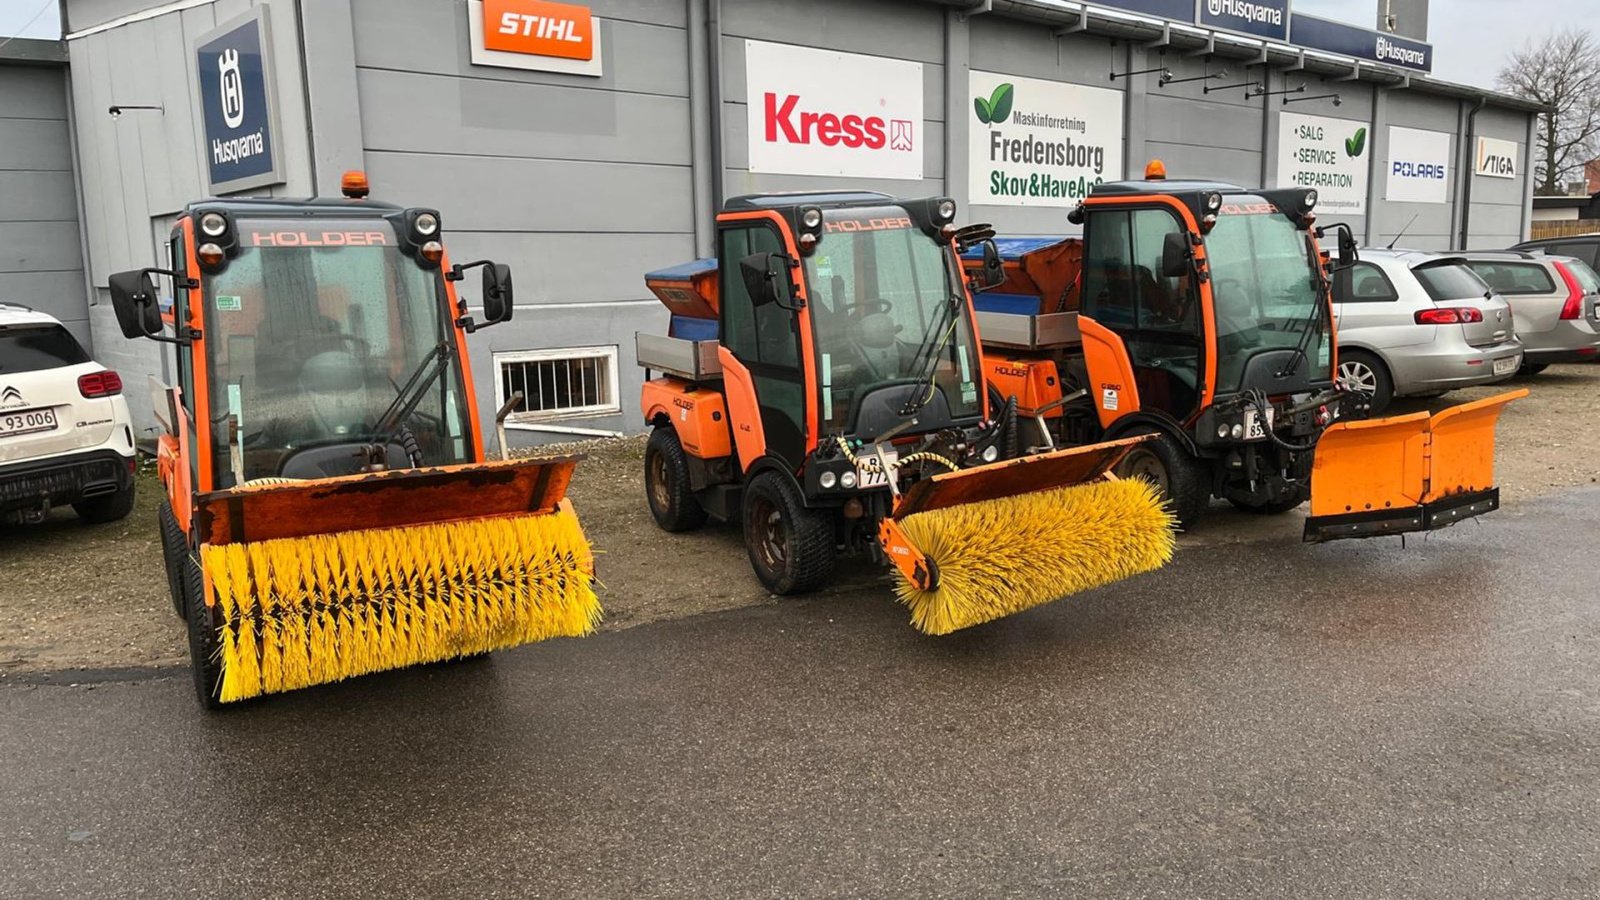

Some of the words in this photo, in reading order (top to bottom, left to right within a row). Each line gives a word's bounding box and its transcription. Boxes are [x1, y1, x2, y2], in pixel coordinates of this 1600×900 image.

[1222, 0, 1281, 25] Husqvarna
[498, 12, 583, 42] STIHL
[1385, 41, 1424, 65] Husqvarna
[764, 92, 886, 150] Kress
[1013, 111, 1086, 134] Maskinforretning
[1300, 125, 1323, 141] SALG
[212, 131, 264, 165] Husqvarna
[990, 130, 1104, 174] Fredensborg
[1298, 148, 1336, 165] SERVICE
[1393, 161, 1445, 179] POLARIS
[1297, 171, 1353, 188] REPARATION
[825, 217, 912, 233] HOLDER
[252, 231, 387, 246] HOLDER
[994, 366, 1029, 378] HOLDER
[5, 416, 24, 430] 93
[26, 411, 53, 427] 006
[1250, 424, 1266, 437] 85
